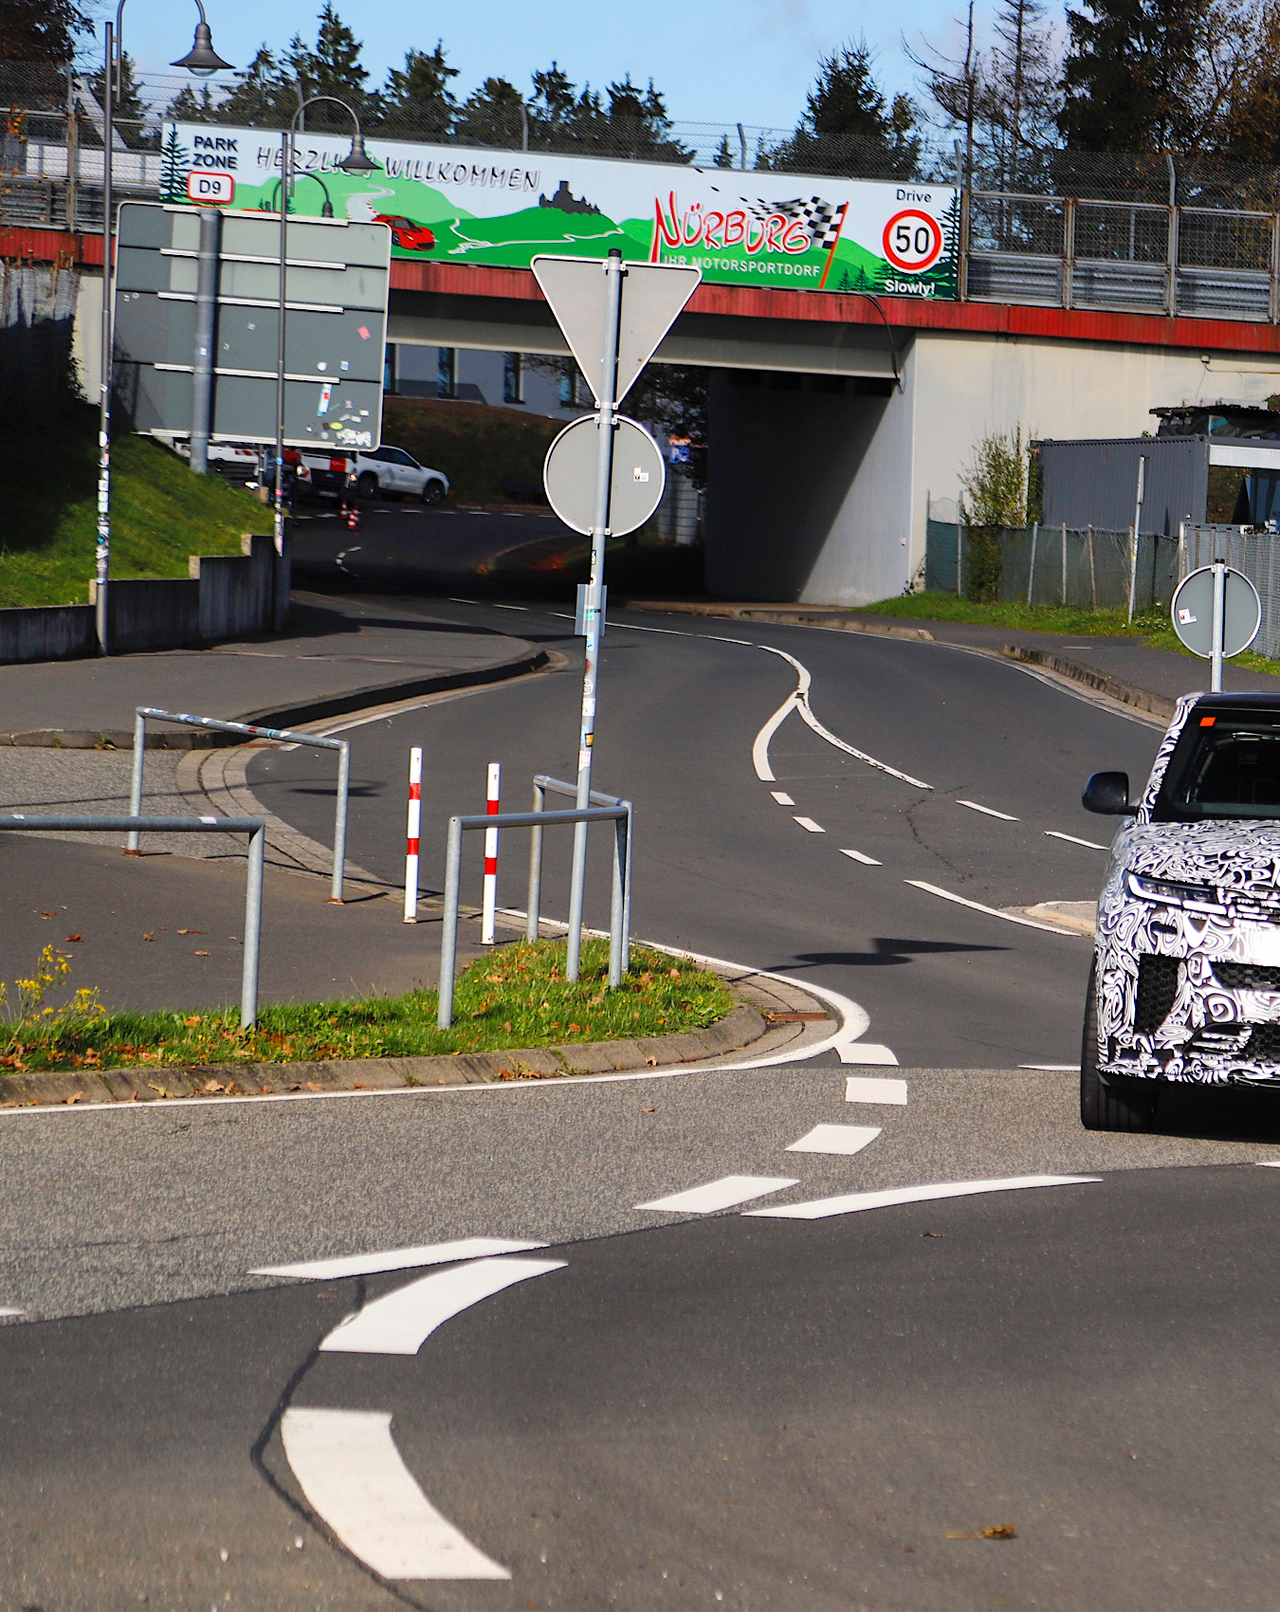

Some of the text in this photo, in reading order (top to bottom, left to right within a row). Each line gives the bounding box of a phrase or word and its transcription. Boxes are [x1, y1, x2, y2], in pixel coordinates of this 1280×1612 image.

[194, 136, 238, 152] PARK
[193, 154, 237, 170] ZONE
[257, 146, 541, 191] HERZLI WILLKOMMEN
[199, 179, 221, 195] D9
[896, 188, 932, 203] Drive
[650, 191, 811, 264] NÜRBURG
[896, 226, 929, 254] 50
[664, 255, 821, 277] IHR MOTORSPORTDORF
[884, 279, 935, 296] Slowly!
